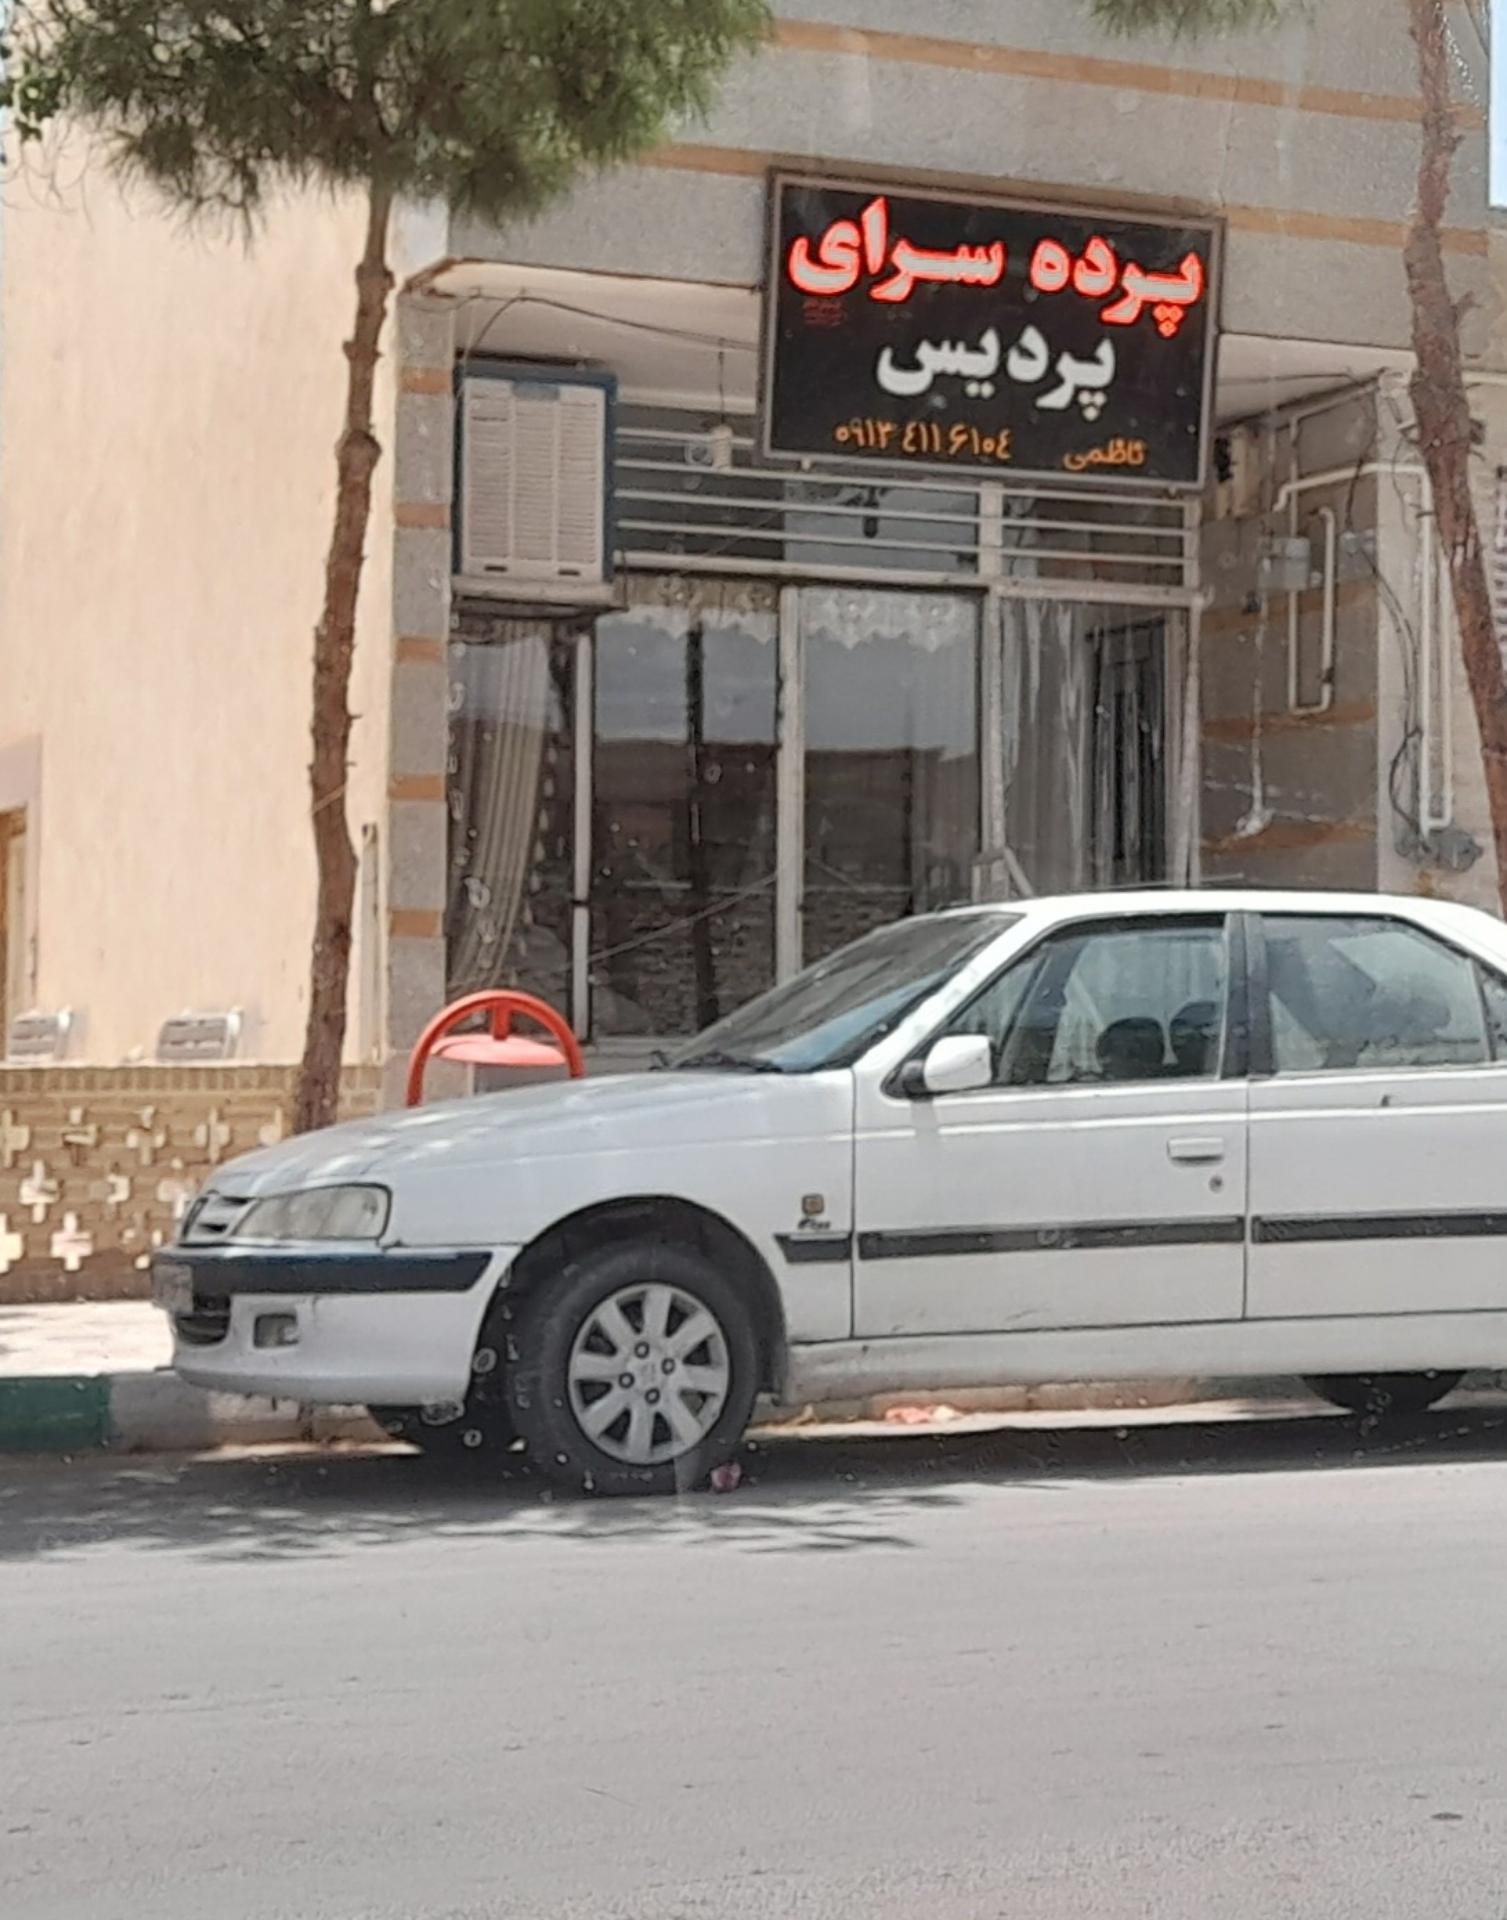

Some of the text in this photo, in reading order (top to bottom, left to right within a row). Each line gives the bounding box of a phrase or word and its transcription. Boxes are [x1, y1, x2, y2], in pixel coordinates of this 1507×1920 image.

[788, 197, 1204, 337] پرده سرای
[876, 324, 1115, 421] پردیس
